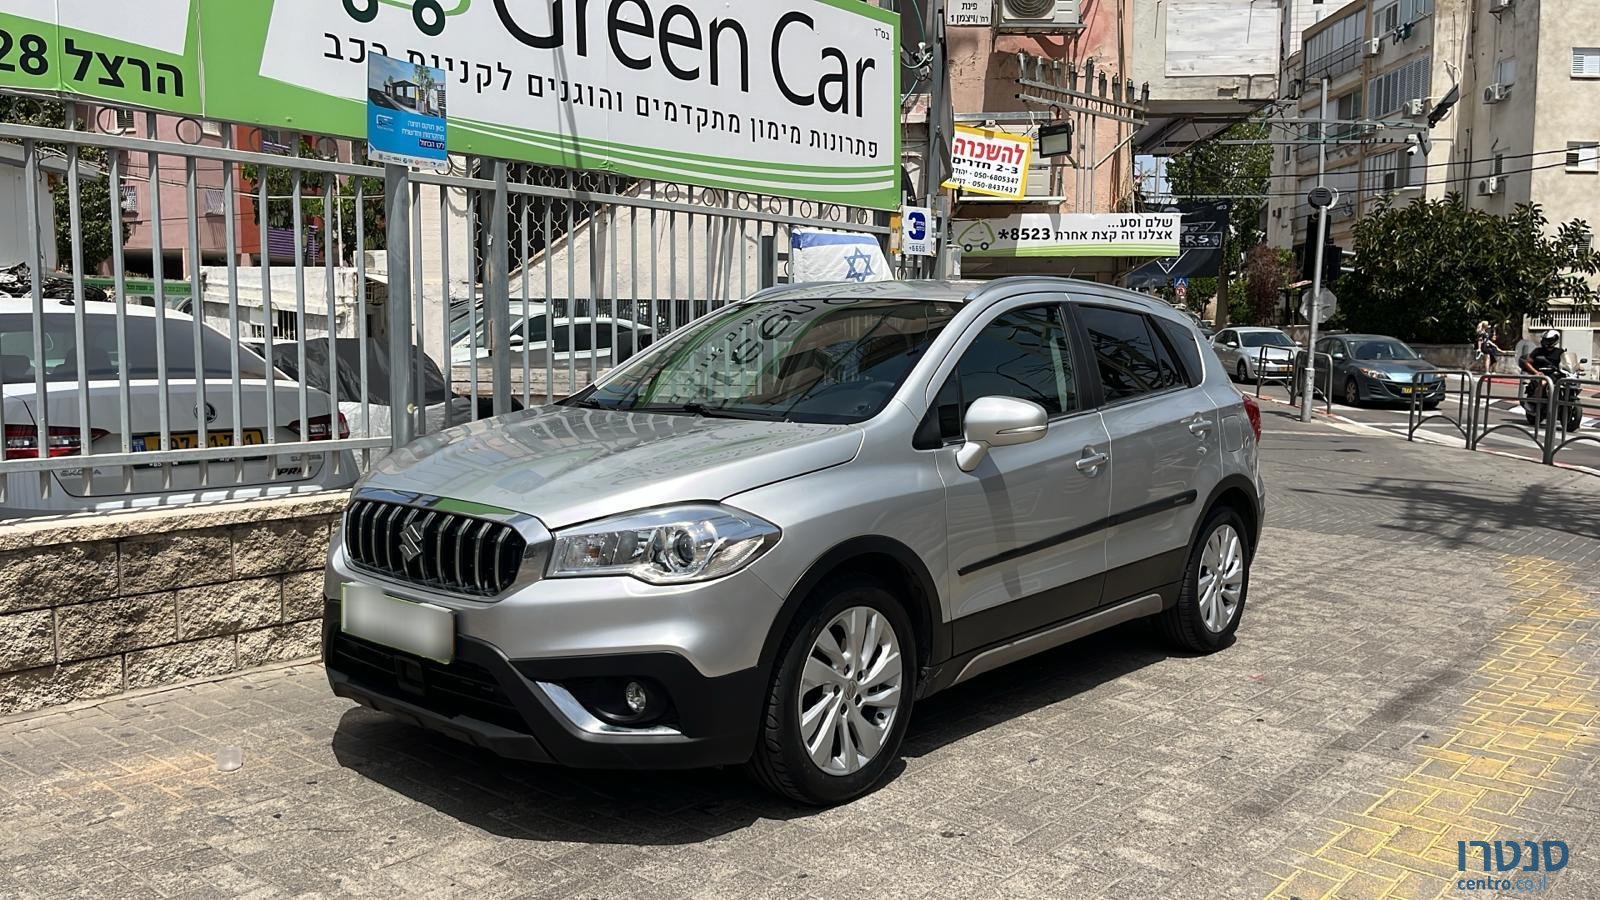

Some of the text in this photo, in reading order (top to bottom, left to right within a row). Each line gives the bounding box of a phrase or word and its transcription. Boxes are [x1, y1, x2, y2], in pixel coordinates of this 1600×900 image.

[962, 2, 978, 10] פינת
[874, 27, 890, 40] בס"ד
[324, 32, 388, 63] רכב
[65, 38, 184, 97] הרצל
[770, 11, 876, 118] Car
[528, 73, 623, 112] והוגנים
[636, 95, 741, 133] מתקדמים
[750, 117, 801, 144] מימון
[809, 128, 878, 158] פתרונות
[953, 138, 1025, 165] להשכרה
[952, 157, 1019, 175] 2-3 חדרים
[974, 171, 1019, 184] 050-6805347
[972, 180, 1018, 194] 050-8437437
[908, 212, 926, 241] 3
[1108, 216, 1173, 228] שלם וסע...
[1054, 230, 1087, 241] אחרת
[1092, 230, 1117, 242] קצת
[1121, 230, 1135, 240] זה
[1138, 229, 1173, 240] אצלנו
